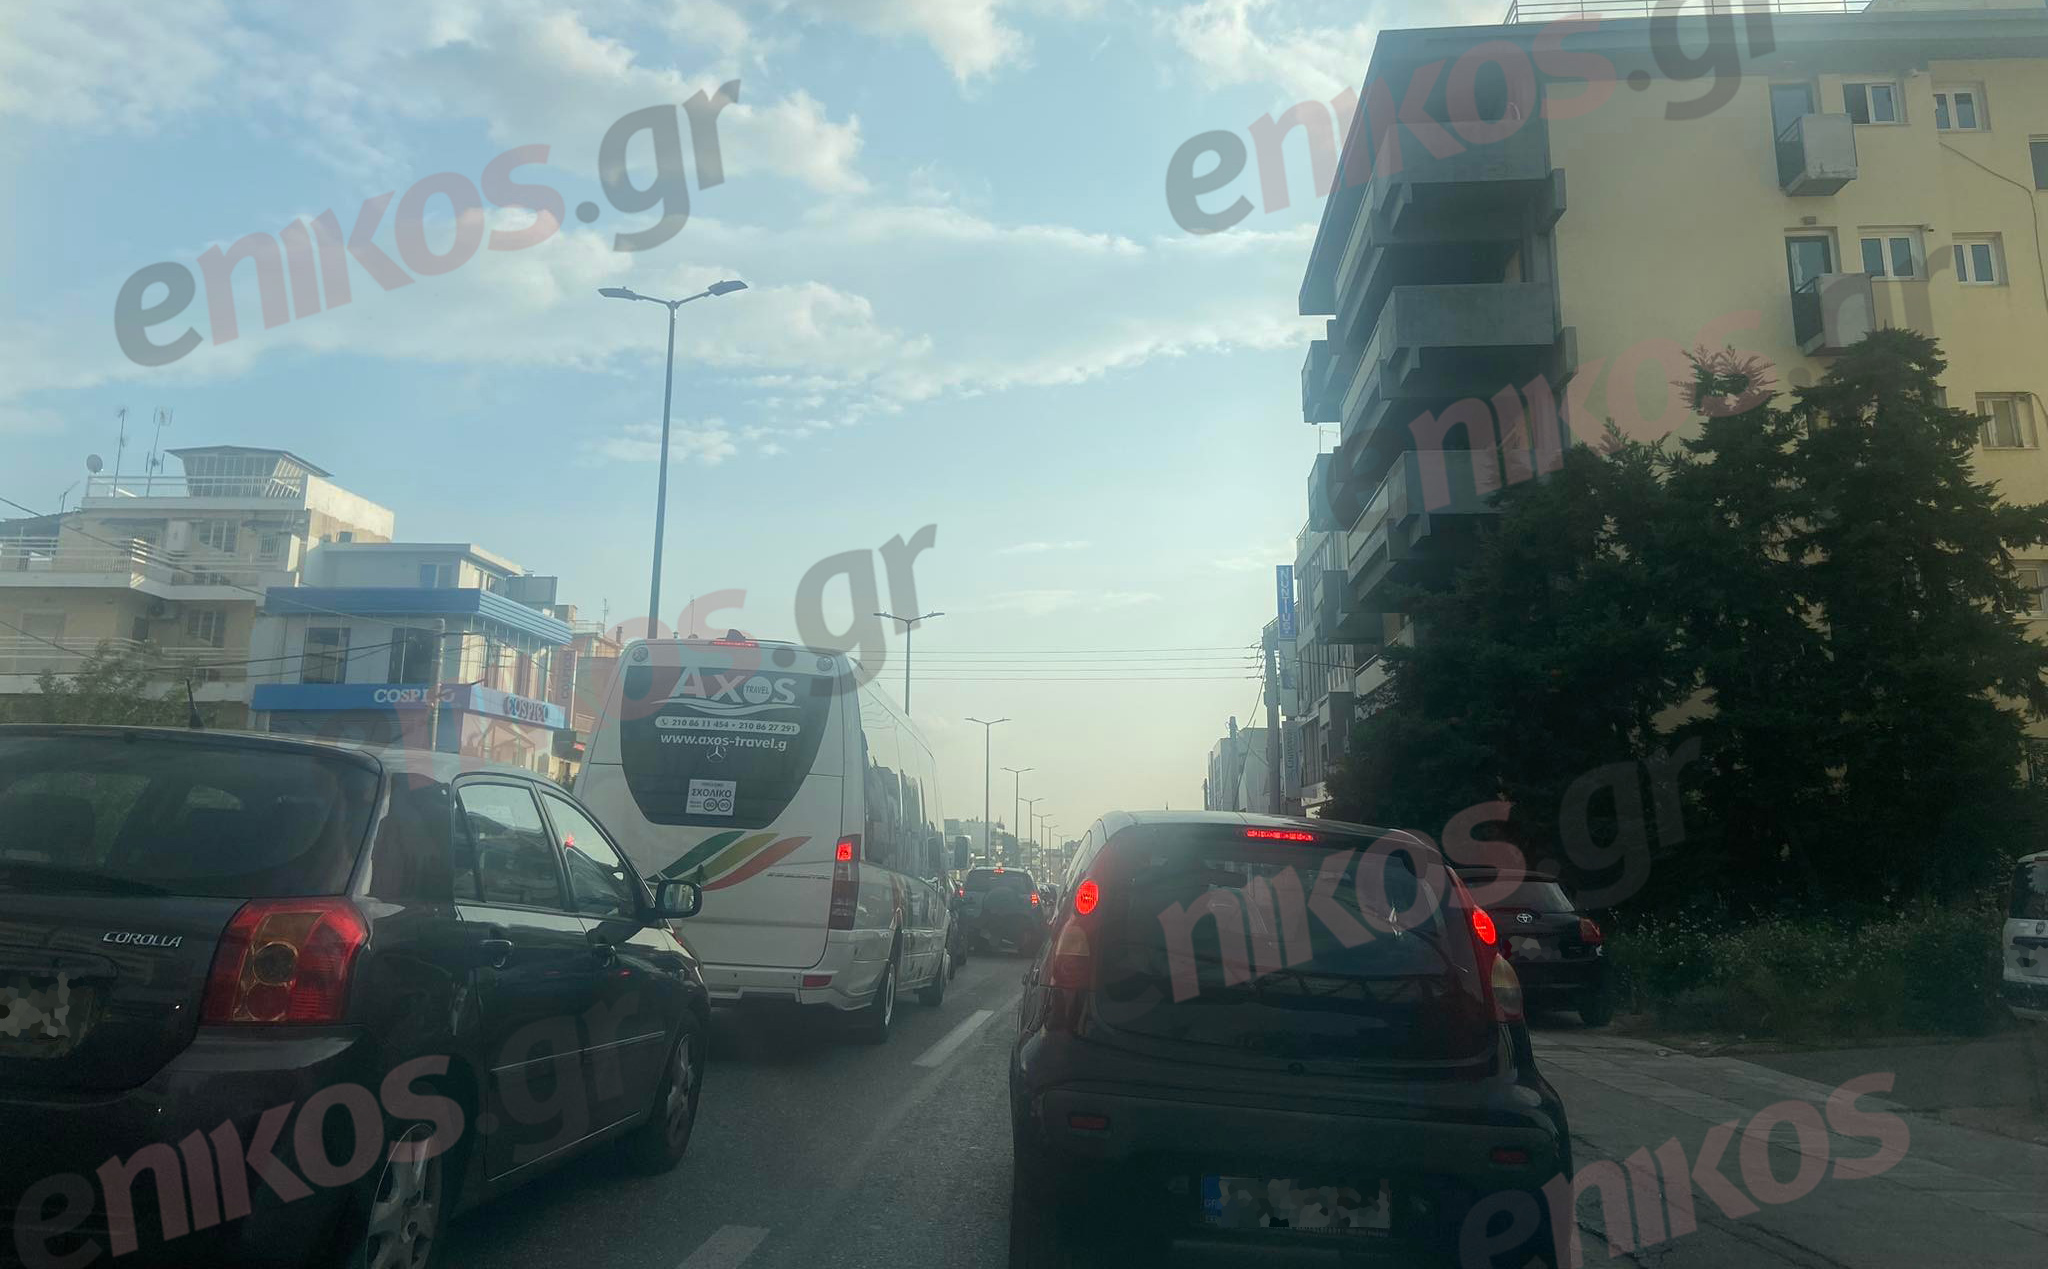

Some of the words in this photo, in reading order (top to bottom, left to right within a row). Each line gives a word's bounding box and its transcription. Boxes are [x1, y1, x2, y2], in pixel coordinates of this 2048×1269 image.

[668, 667, 797, 704] AXOS
[745, 685, 770, 695] TRAVEL
[374, 688, 456, 703] COSPIO
[672, 719, 687, 727] 210
[702, 720, 711, 728] 11
[714, 720, 729, 728] 454
[739, 722, 754, 730] 210
[102, 931, 184, 948] COROLLA
